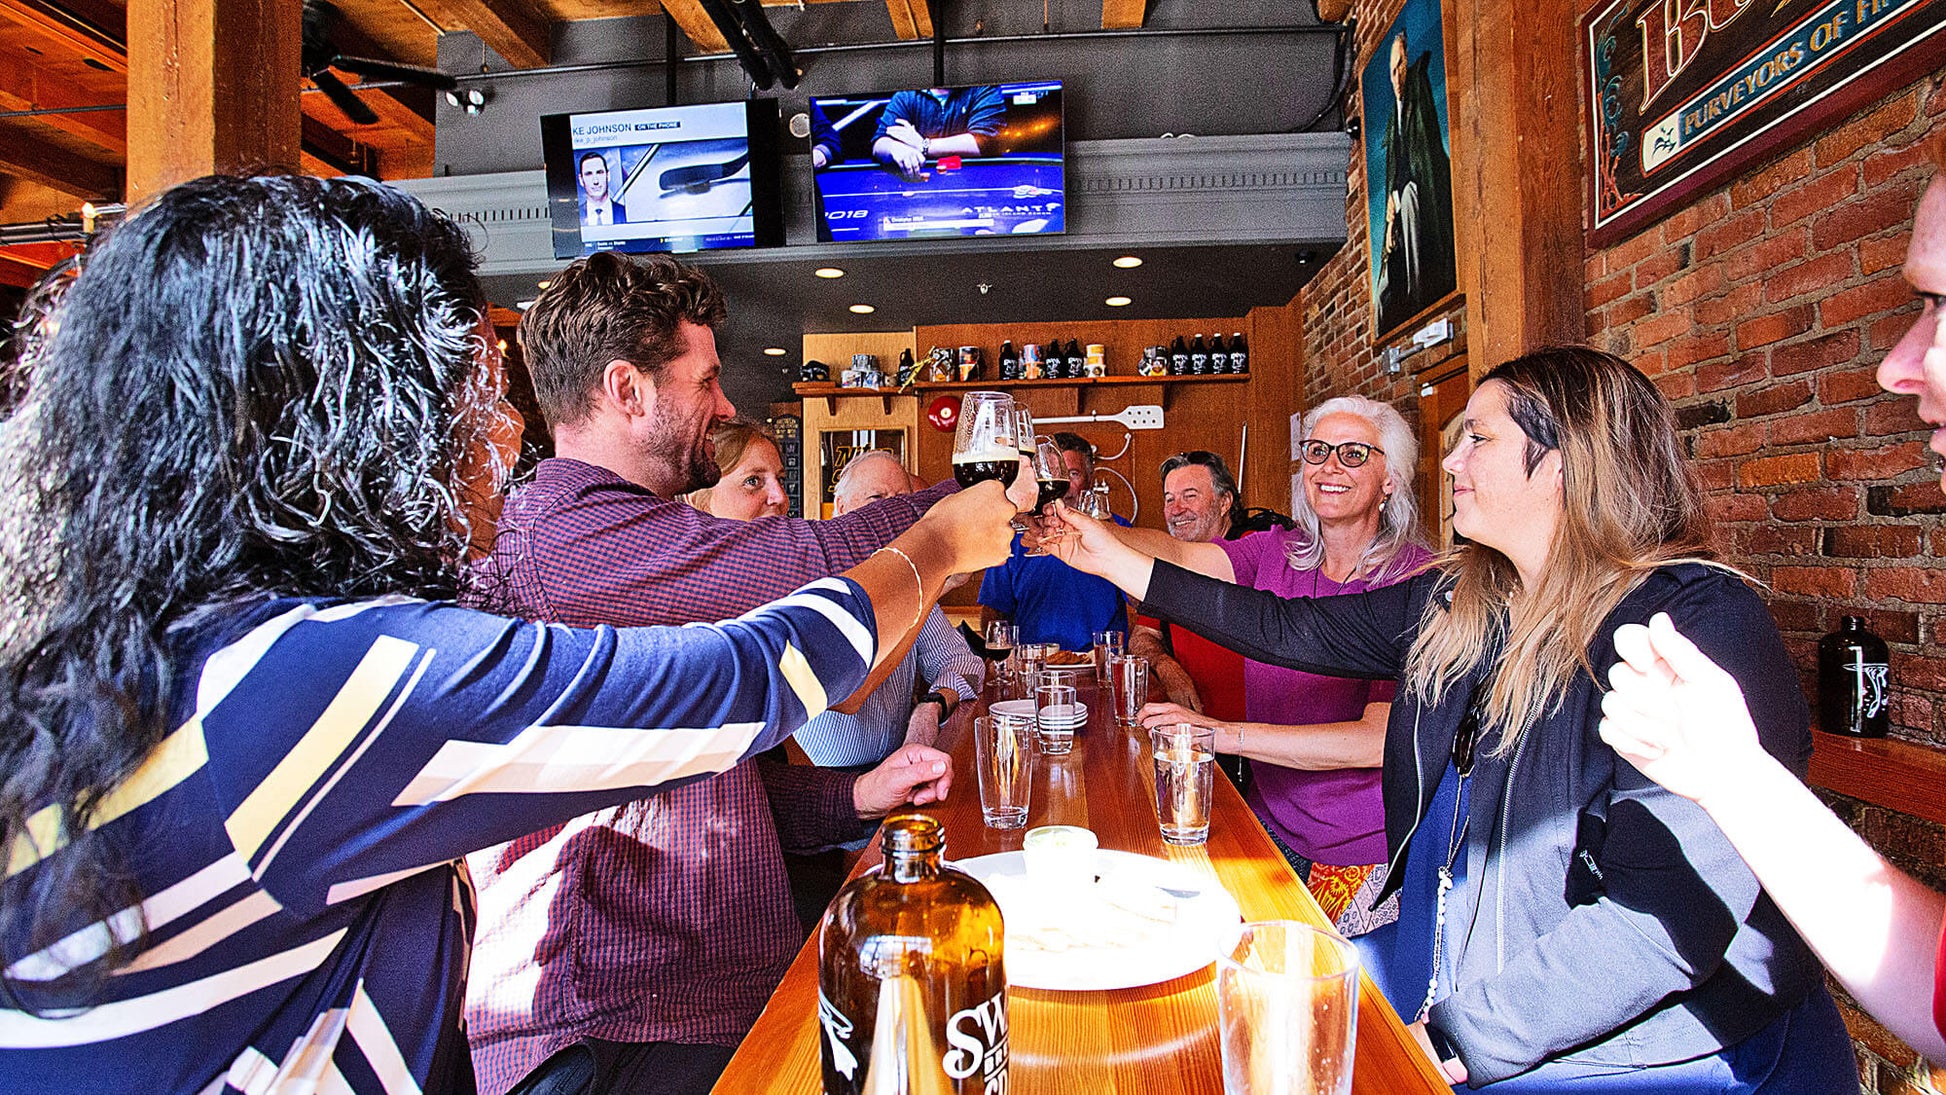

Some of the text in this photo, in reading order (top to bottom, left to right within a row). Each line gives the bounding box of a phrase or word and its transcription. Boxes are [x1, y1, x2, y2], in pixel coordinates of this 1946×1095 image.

[1683, 41, 1804, 137] PURVEYORS
[1809, 10, 1848, 52] OF
[586, 123, 632, 135] JOHNSON
